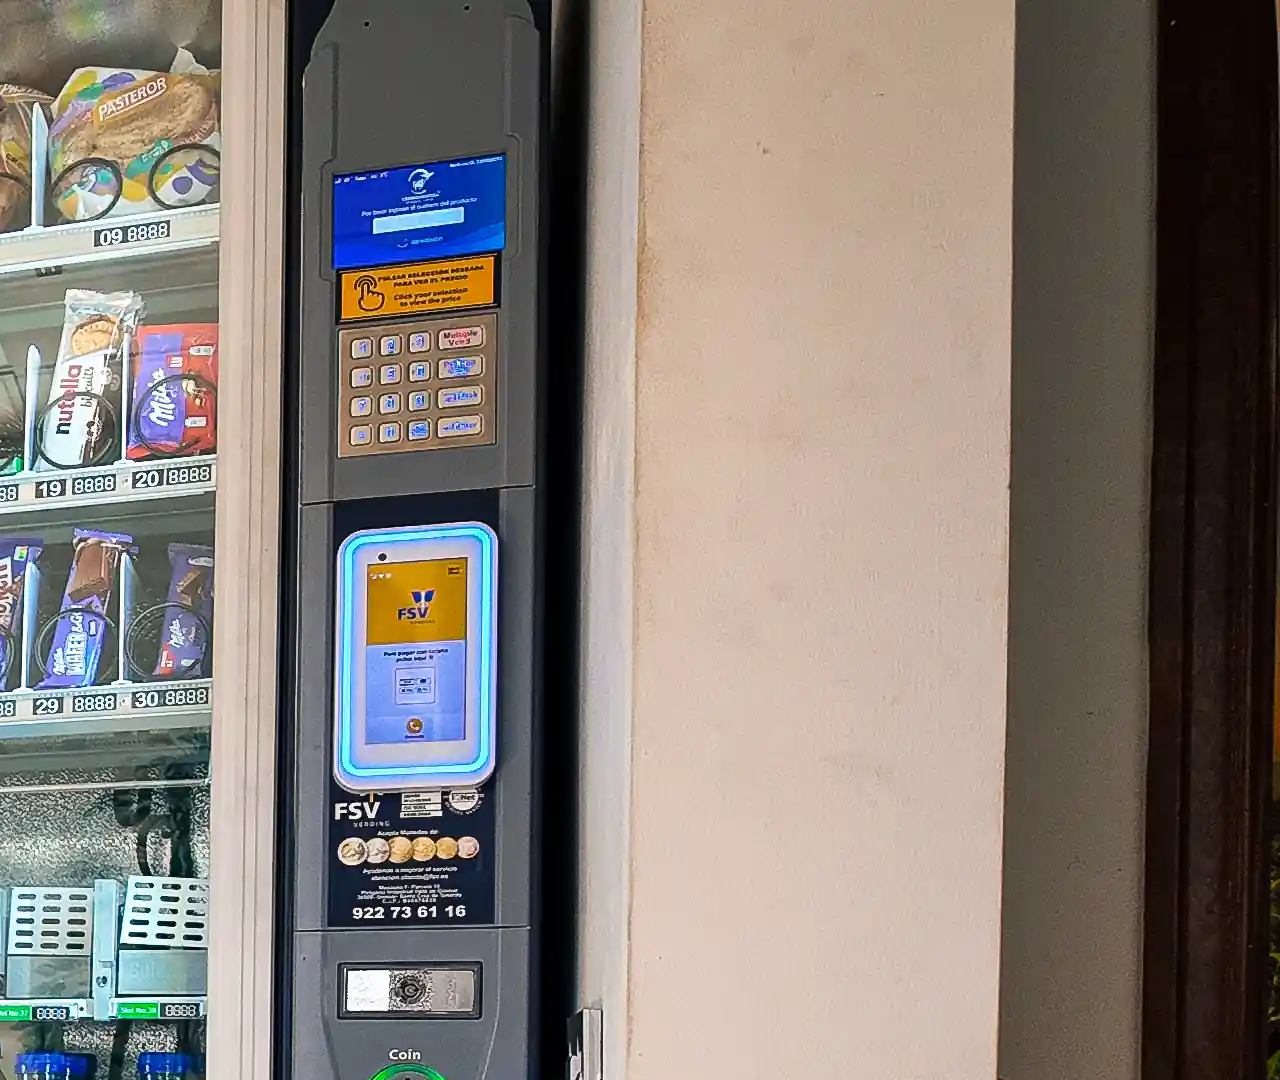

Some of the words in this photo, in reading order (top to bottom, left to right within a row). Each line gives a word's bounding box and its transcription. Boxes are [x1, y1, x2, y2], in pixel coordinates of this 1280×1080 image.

[99, 77, 167, 121] PASTEROR
[99, 229, 122, 246] 09
[56, 365, 82, 434] nutella
[136, 471, 158, 487] 20
[39, 481, 61, 496] 19
[397, 607, 430, 620] FSV
[36, 699, 59, 714] 29
[135, 692, 158, 707] 30
[334, 802, 380, 820] FSV
[353, 907, 384, 919] 922
[390, 907, 411, 918] 73
[417, 906, 437, 917] 61
[445, 905, 466, 917] 16
[389, 1049, 421, 1061] Coin
